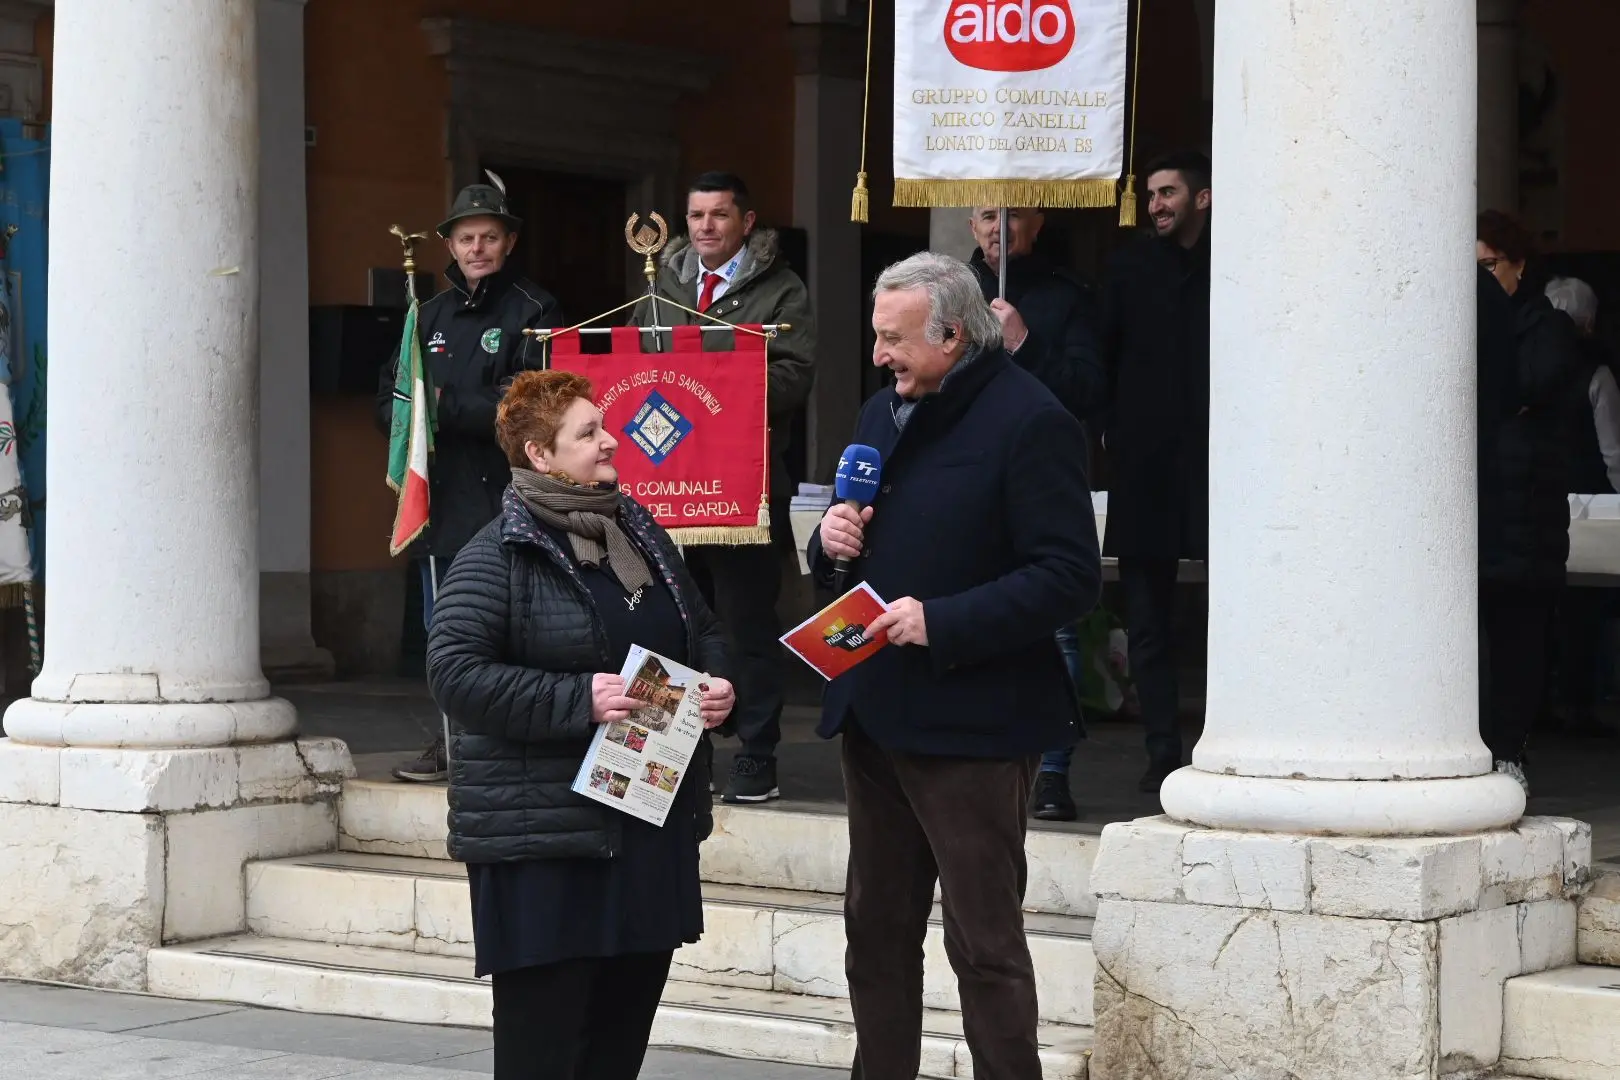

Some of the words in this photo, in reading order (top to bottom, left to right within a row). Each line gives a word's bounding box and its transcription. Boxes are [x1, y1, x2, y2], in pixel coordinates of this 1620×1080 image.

[951, 0, 1067, 45] aido
[911, 88, 987, 105] GRUPPO
[995, 88, 1107, 107] COMUNALE
[931, 111, 995, 128] MIRCO
[1004, 111, 1087, 130] ZANELLI
[926, 135, 985, 151] LONATO
[1015, 135, 1067, 153] GARDA
[1074, 137, 1093, 153] BS
[596, 378, 630, 415] HARITAS
[630, 369, 658, 388] USQUE
[661, 370, 676, 384] AD
[678, 373, 723, 416] SANGUINEM
[636, 480, 723, 496] COMUNALE
[647, 503, 677, 518] DEL
[683, 500, 741, 517] GARDA
[825, 632, 845, 646] PIAZZA
[846, 633, 866, 648] NOI
